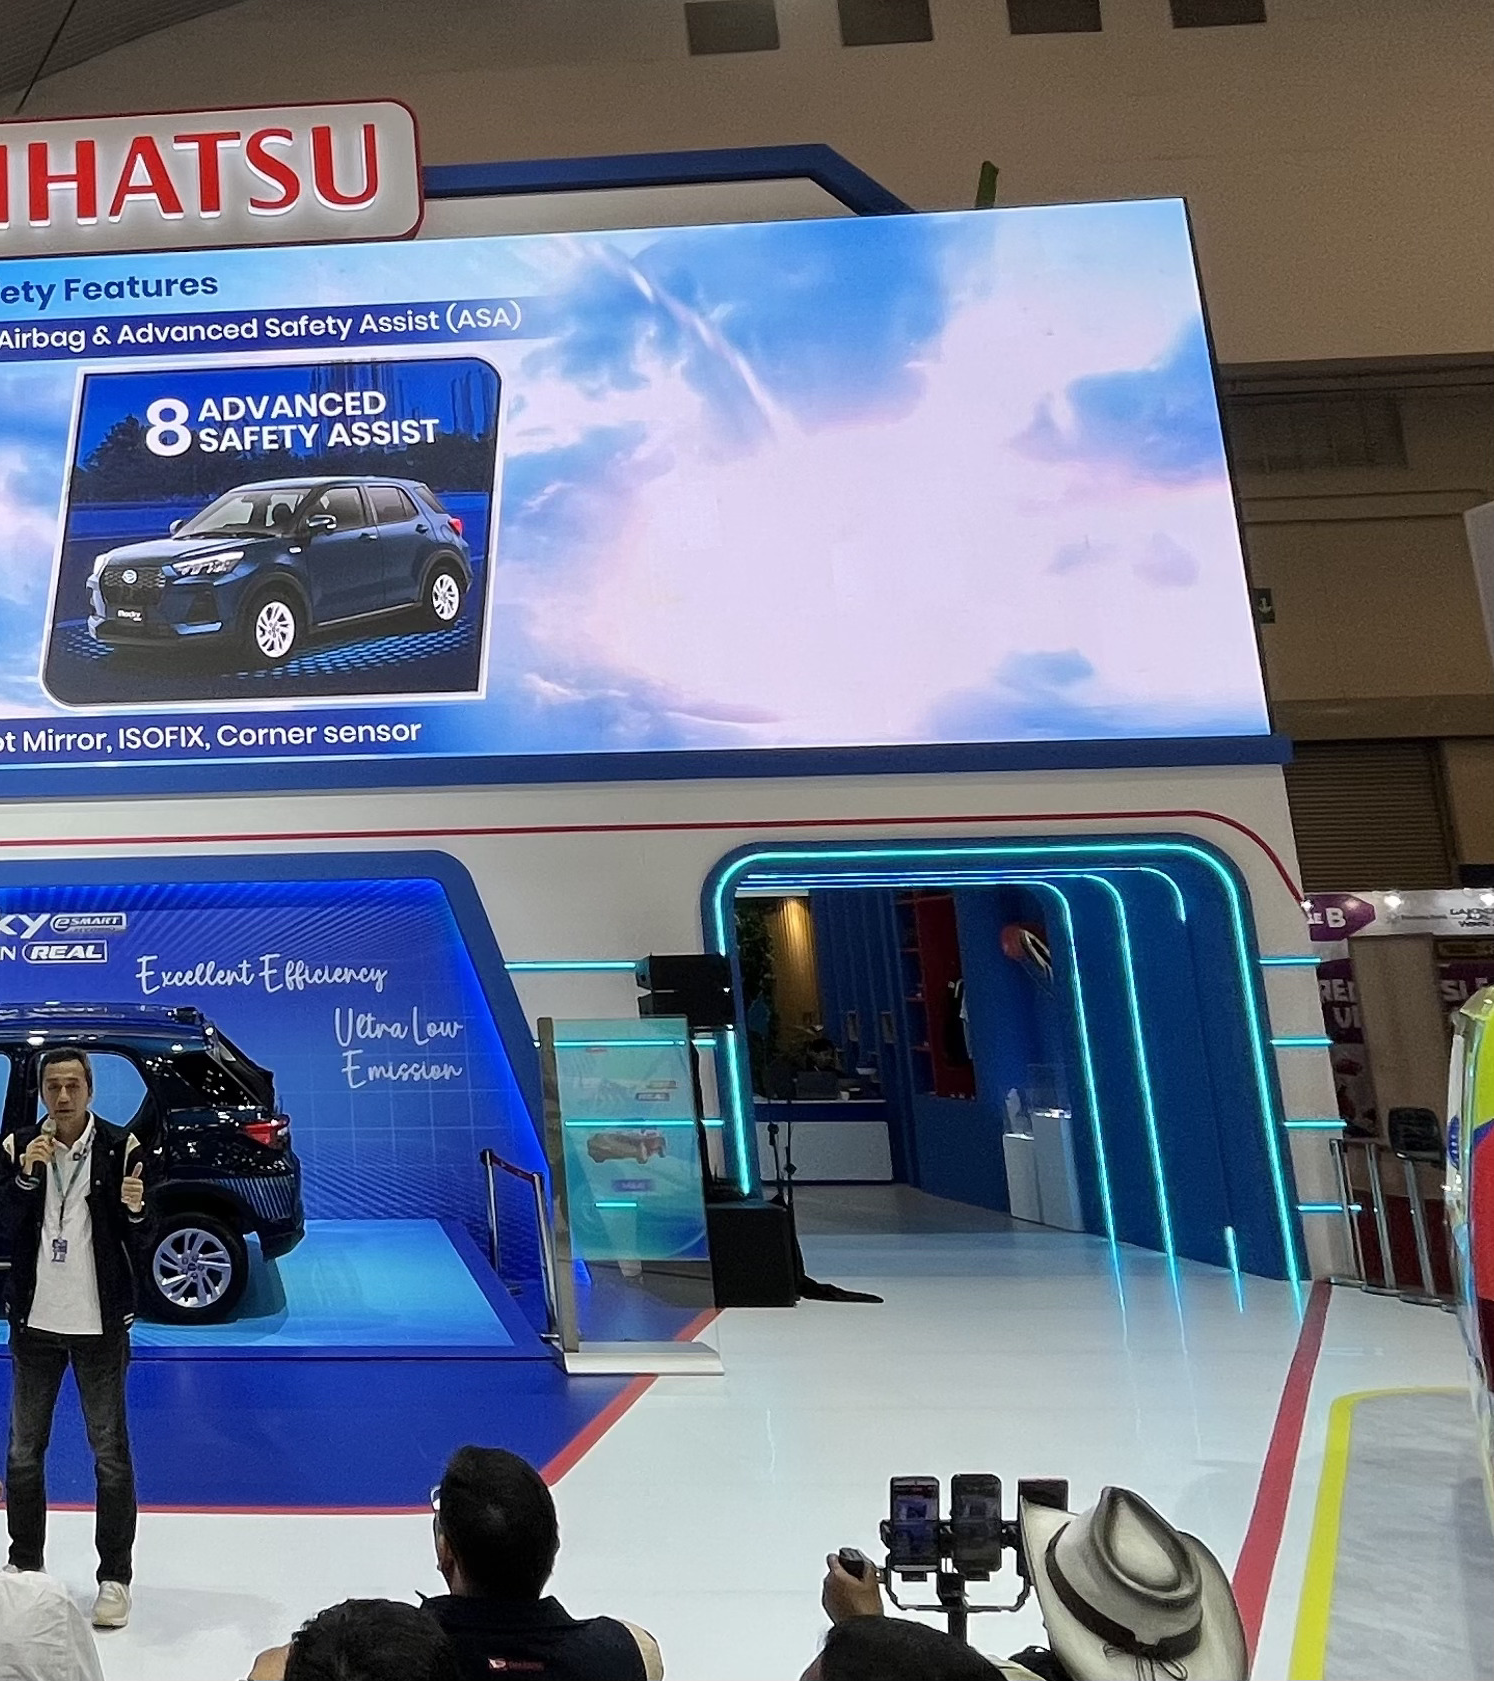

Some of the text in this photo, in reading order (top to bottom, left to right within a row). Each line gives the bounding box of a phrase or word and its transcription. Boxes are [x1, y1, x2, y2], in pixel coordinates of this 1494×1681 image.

[64, 274, 219, 301] Features
[92, 324, 111, 345] &
[117, 318, 258, 345] Advanced
[264, 314, 353, 341] Safety
[359, 309, 440, 334] Assist
[446, 299, 523, 333] (ASA)
[198, 390, 387, 422] ADVANCED
[145, 398, 192, 457] 8
[198, 418, 440, 453] SAFETY ASSIST
[22, 728, 113, 754] Mirror,
[118, 725, 211, 751] ISOFIX,
[216, 722, 317, 747] Corner
[323, 721, 423, 744] sensor
[1325, 907, 1346, 928] B
[29, 944, 103, 960] REAL
[135, 953, 389, 995] Excellent Efficiency
[333, 1005, 464, 1048] Ultra Low
[341, 1049, 463, 1090] Emission
